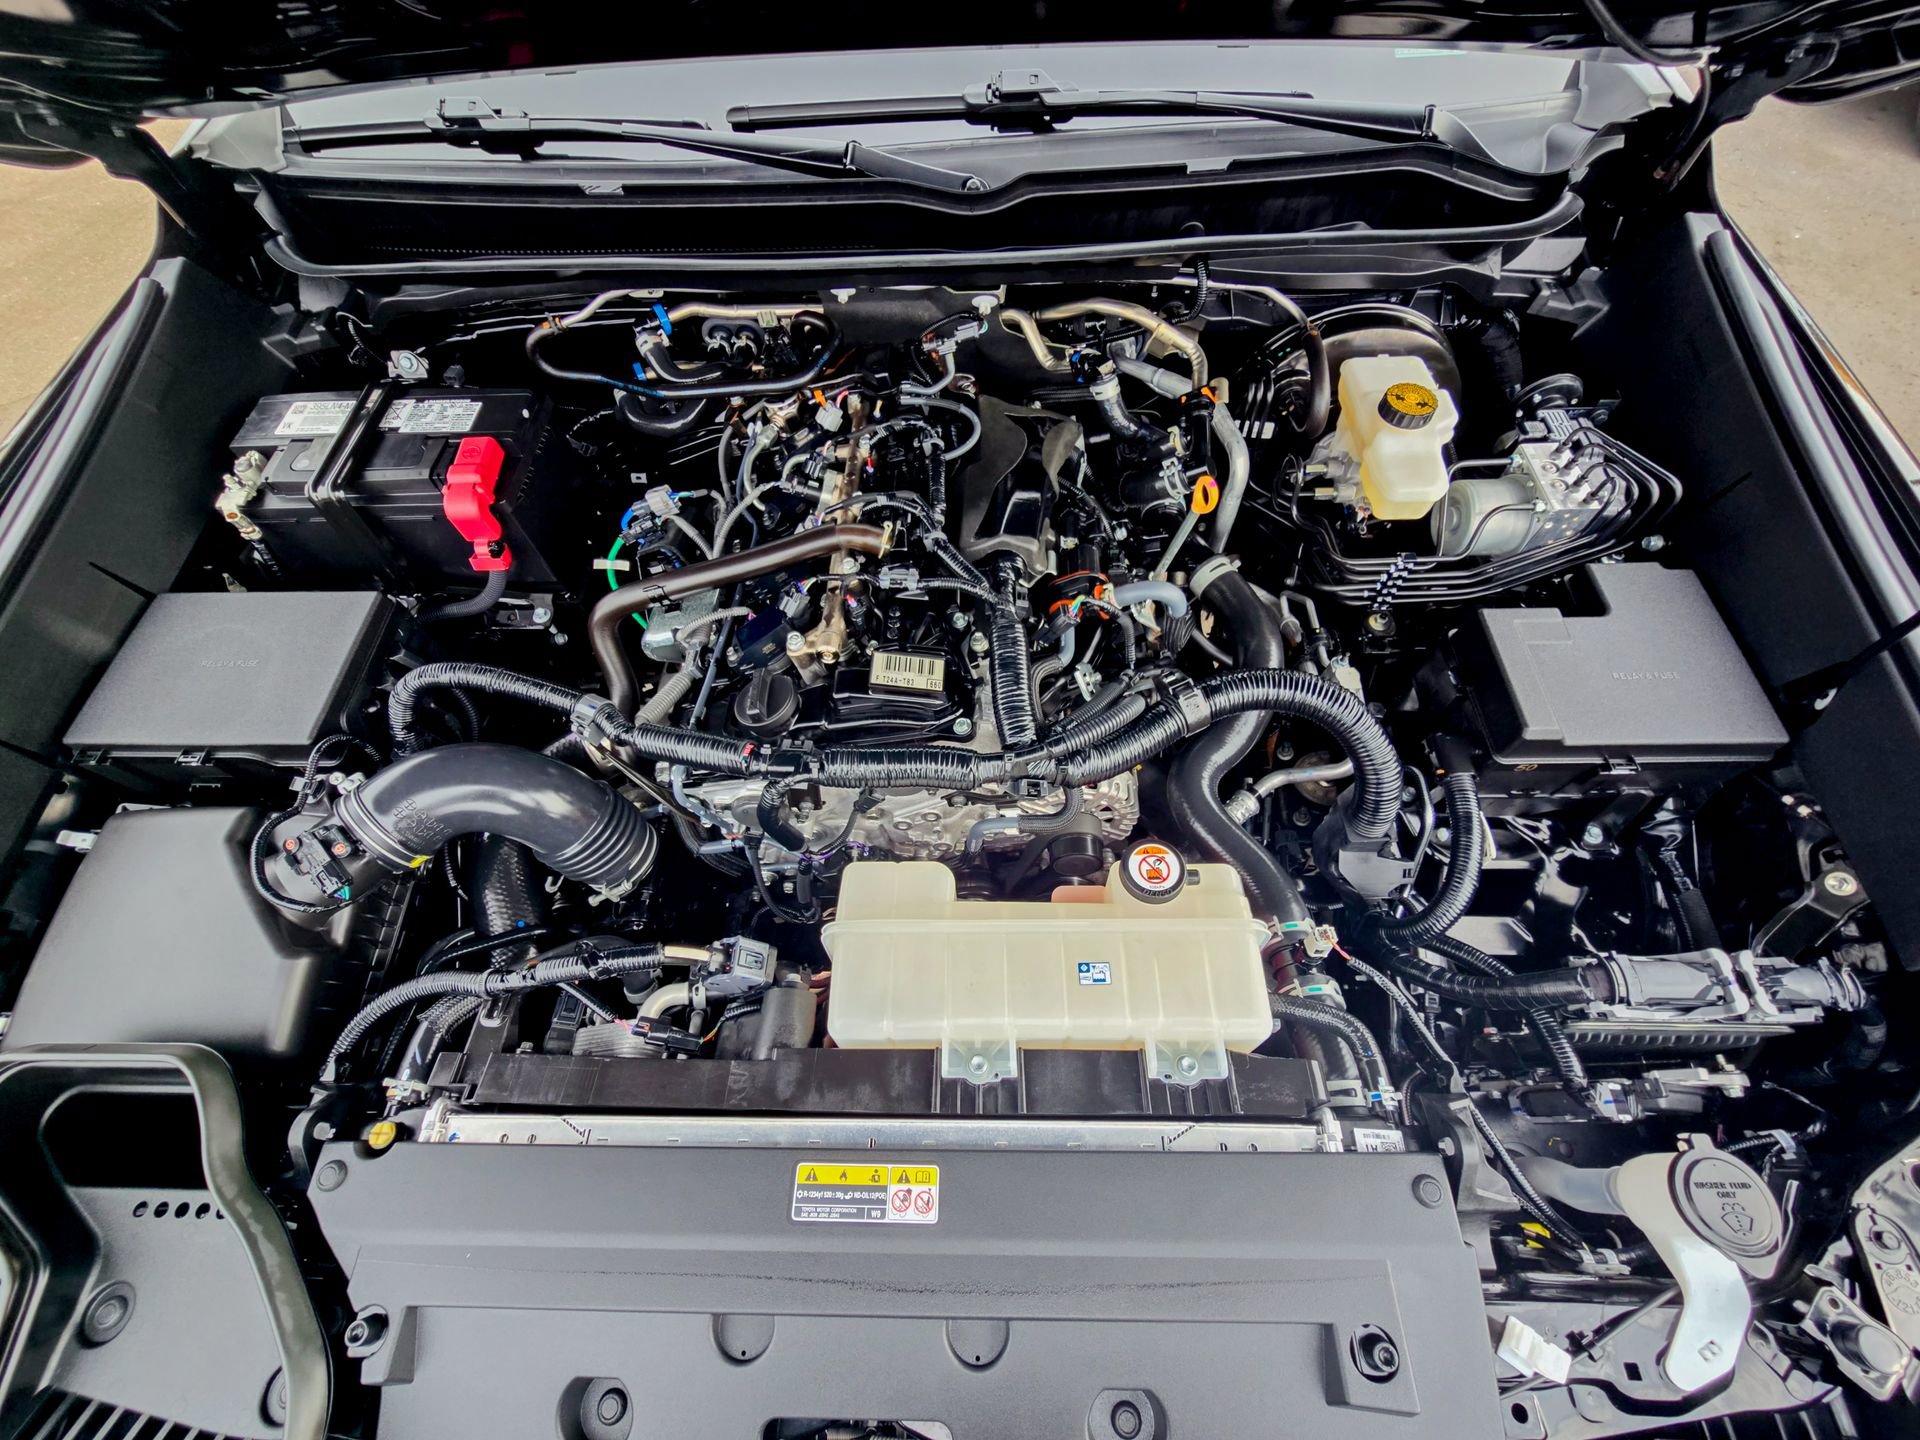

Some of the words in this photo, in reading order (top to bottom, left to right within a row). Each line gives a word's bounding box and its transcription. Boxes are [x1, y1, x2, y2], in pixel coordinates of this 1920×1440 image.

[1611, 672, 1642, 680] RELAY
[1693, 1182, 1727, 1190] WASHER
[1728, 1182, 1752, 1190] FLUID
[1716, 1191, 1737, 1199] ONLY
[870, 1210, 882, 1219] W9
